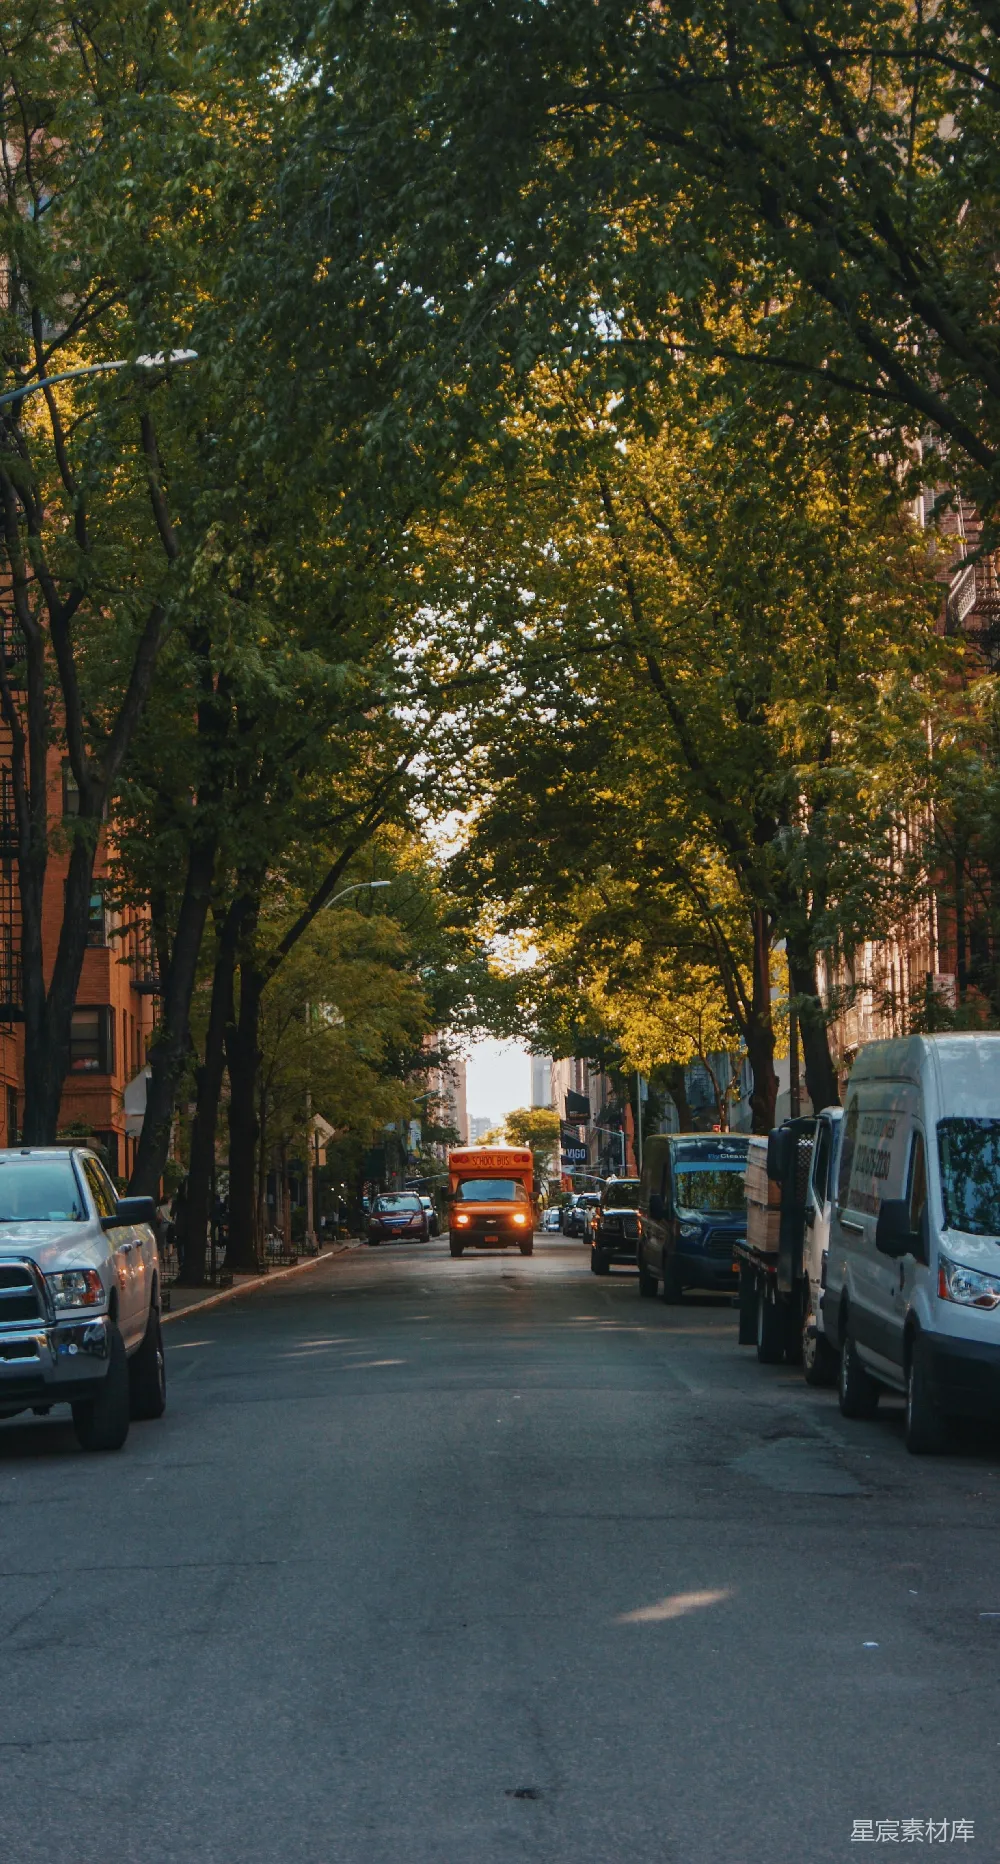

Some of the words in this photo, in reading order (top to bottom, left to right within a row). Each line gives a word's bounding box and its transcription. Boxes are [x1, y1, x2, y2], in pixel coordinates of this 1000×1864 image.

[567, 1148, 586, 1159] VIGO
[473, 1156, 495, 1166] SCHOOL
[497, 1155, 509, 1166] BUS
